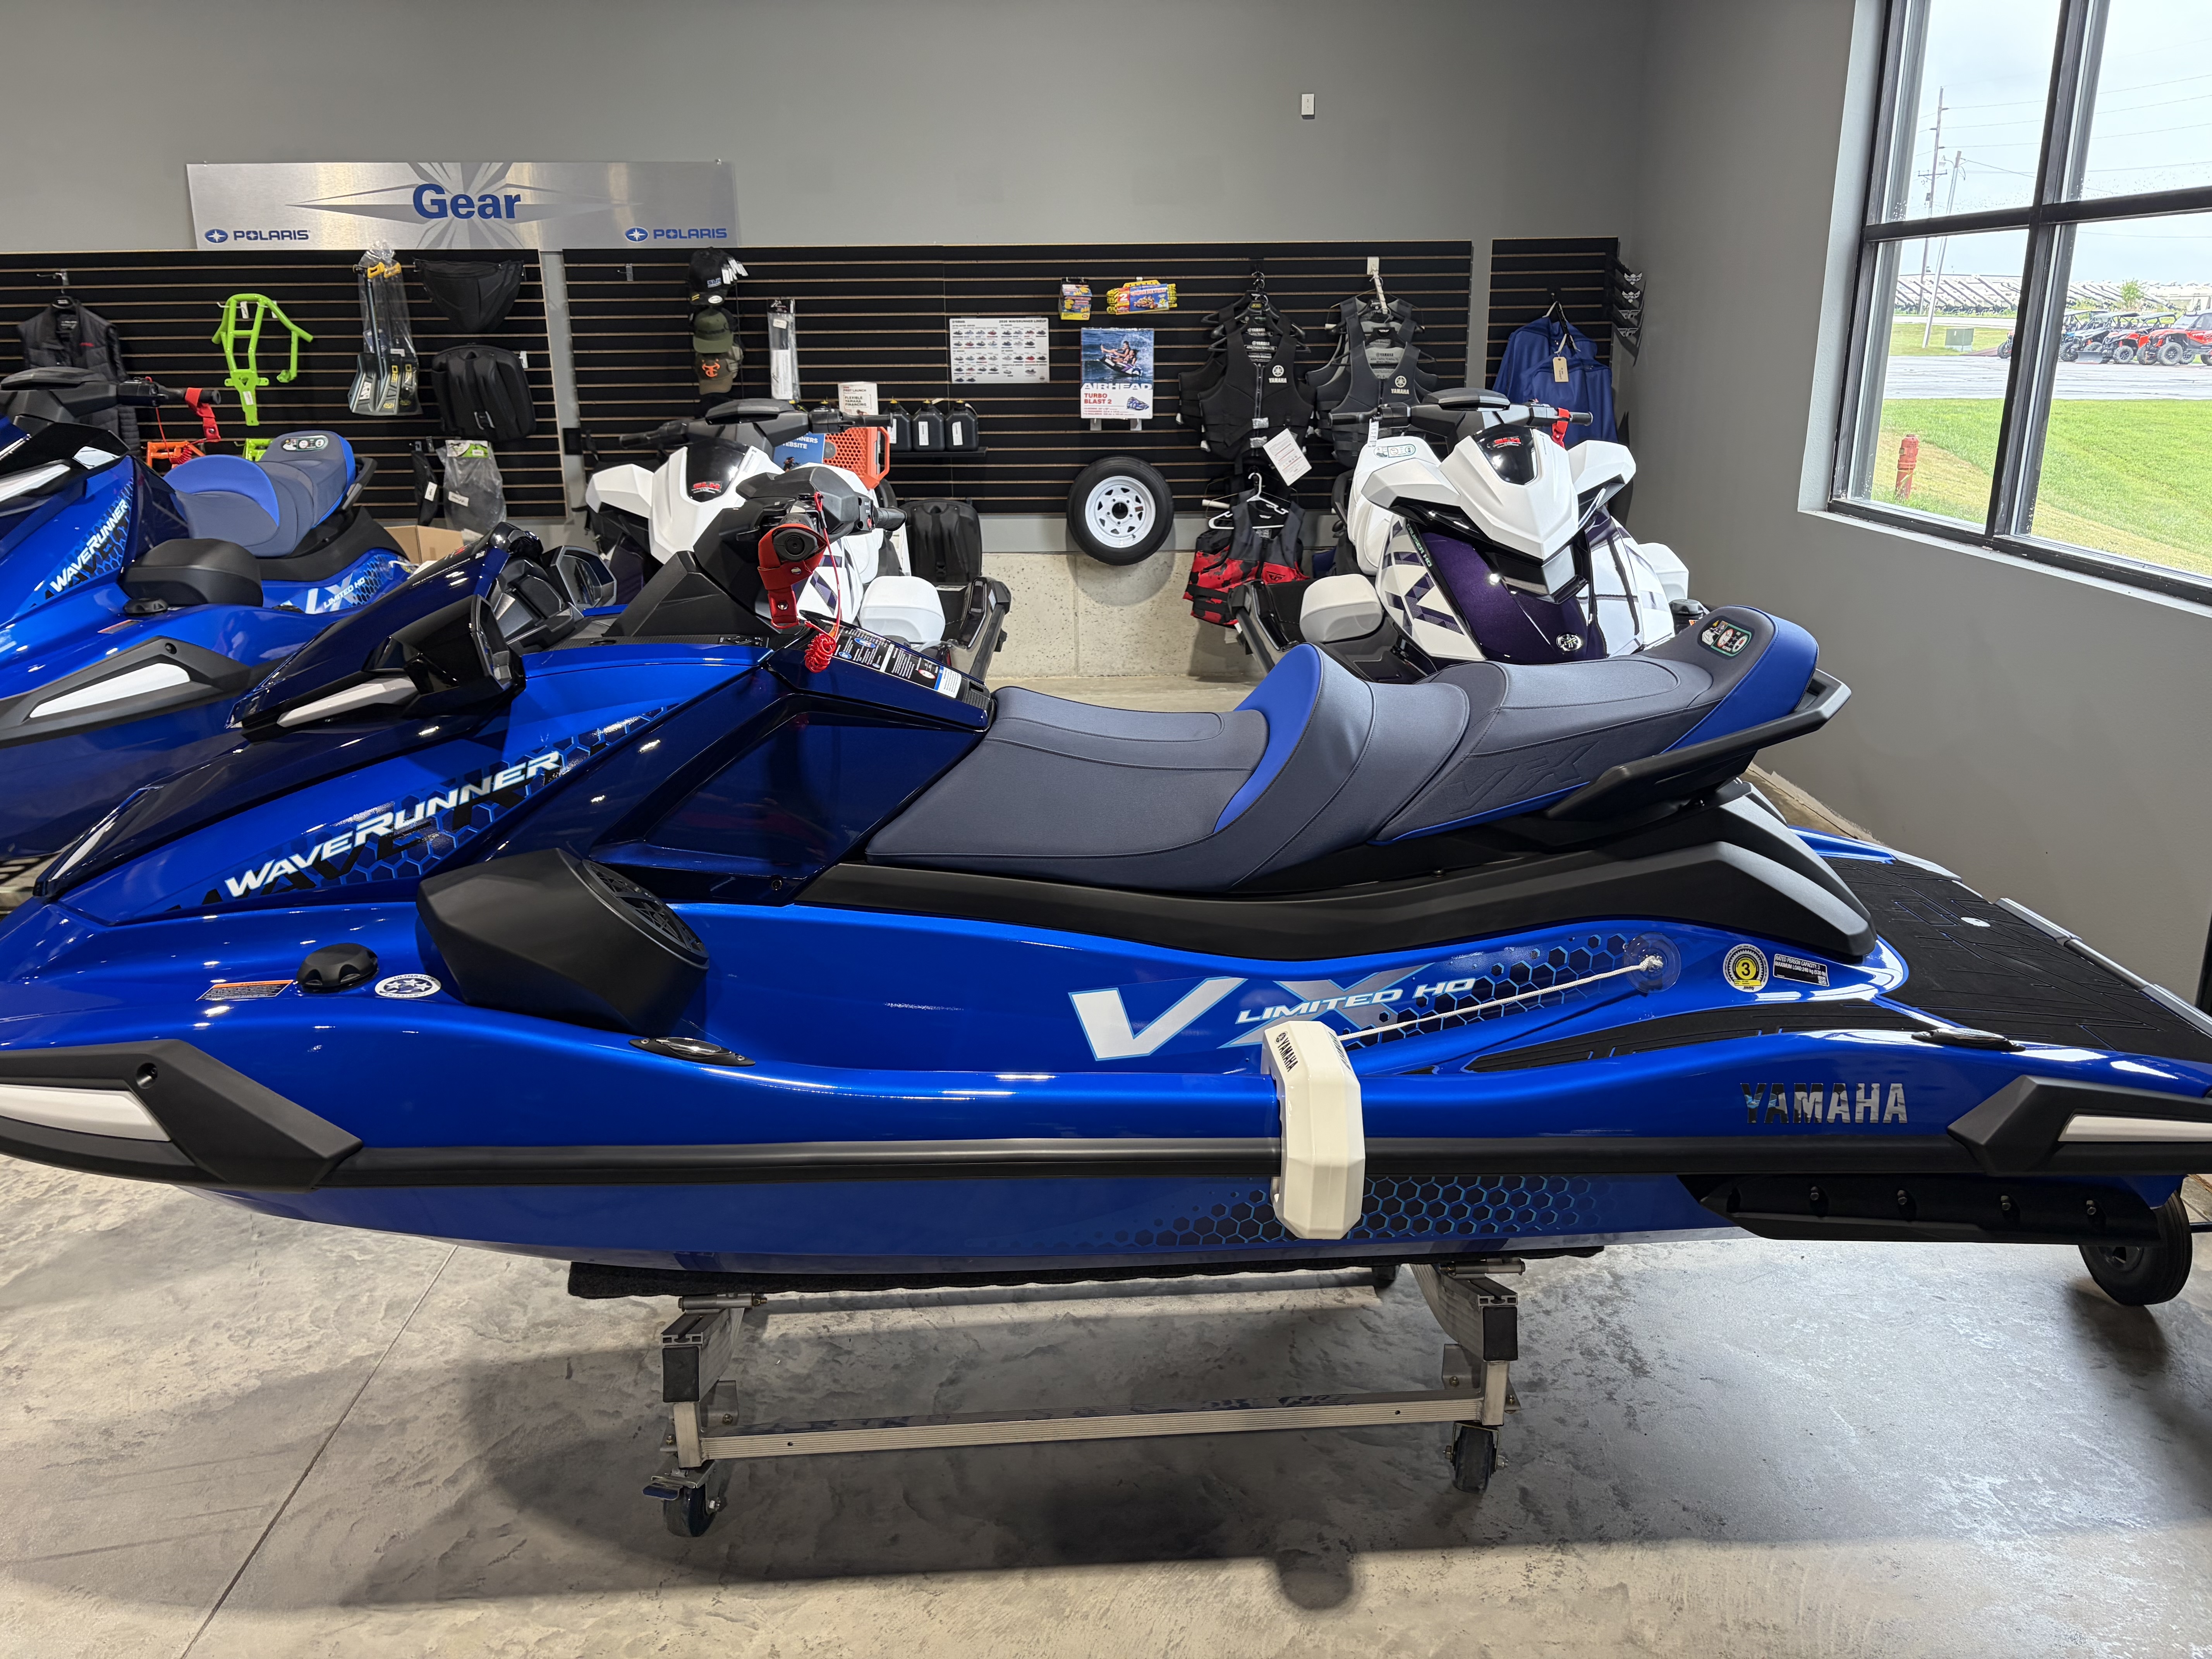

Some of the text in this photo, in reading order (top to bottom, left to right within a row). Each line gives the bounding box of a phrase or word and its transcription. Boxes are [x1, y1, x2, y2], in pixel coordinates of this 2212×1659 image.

[413, 184, 521, 219] Gear
[233, 230, 309, 240] POLARIS
[653, 228, 727, 239] POLARIS
[1119, 293, 1128, 301] 2
[50, 499, 128, 592] WAVERUNNER
[323, 577, 366, 609] LIMITED HO
[225, 750, 560, 897] WAVERUNNER
[1741, 962, 1750, 976] 3
[1775, 961, 1792, 969] MAXIMUM
[1787, 957, 1801, 965] PERSON
[1068, 962, 1434, 1061] VX
[1235, 977, 1476, 1024] LIMITED HO
[1278, 1037, 1298, 1073] YAMAHA
[1740, 1083, 1908, 1124] YAMAHA
